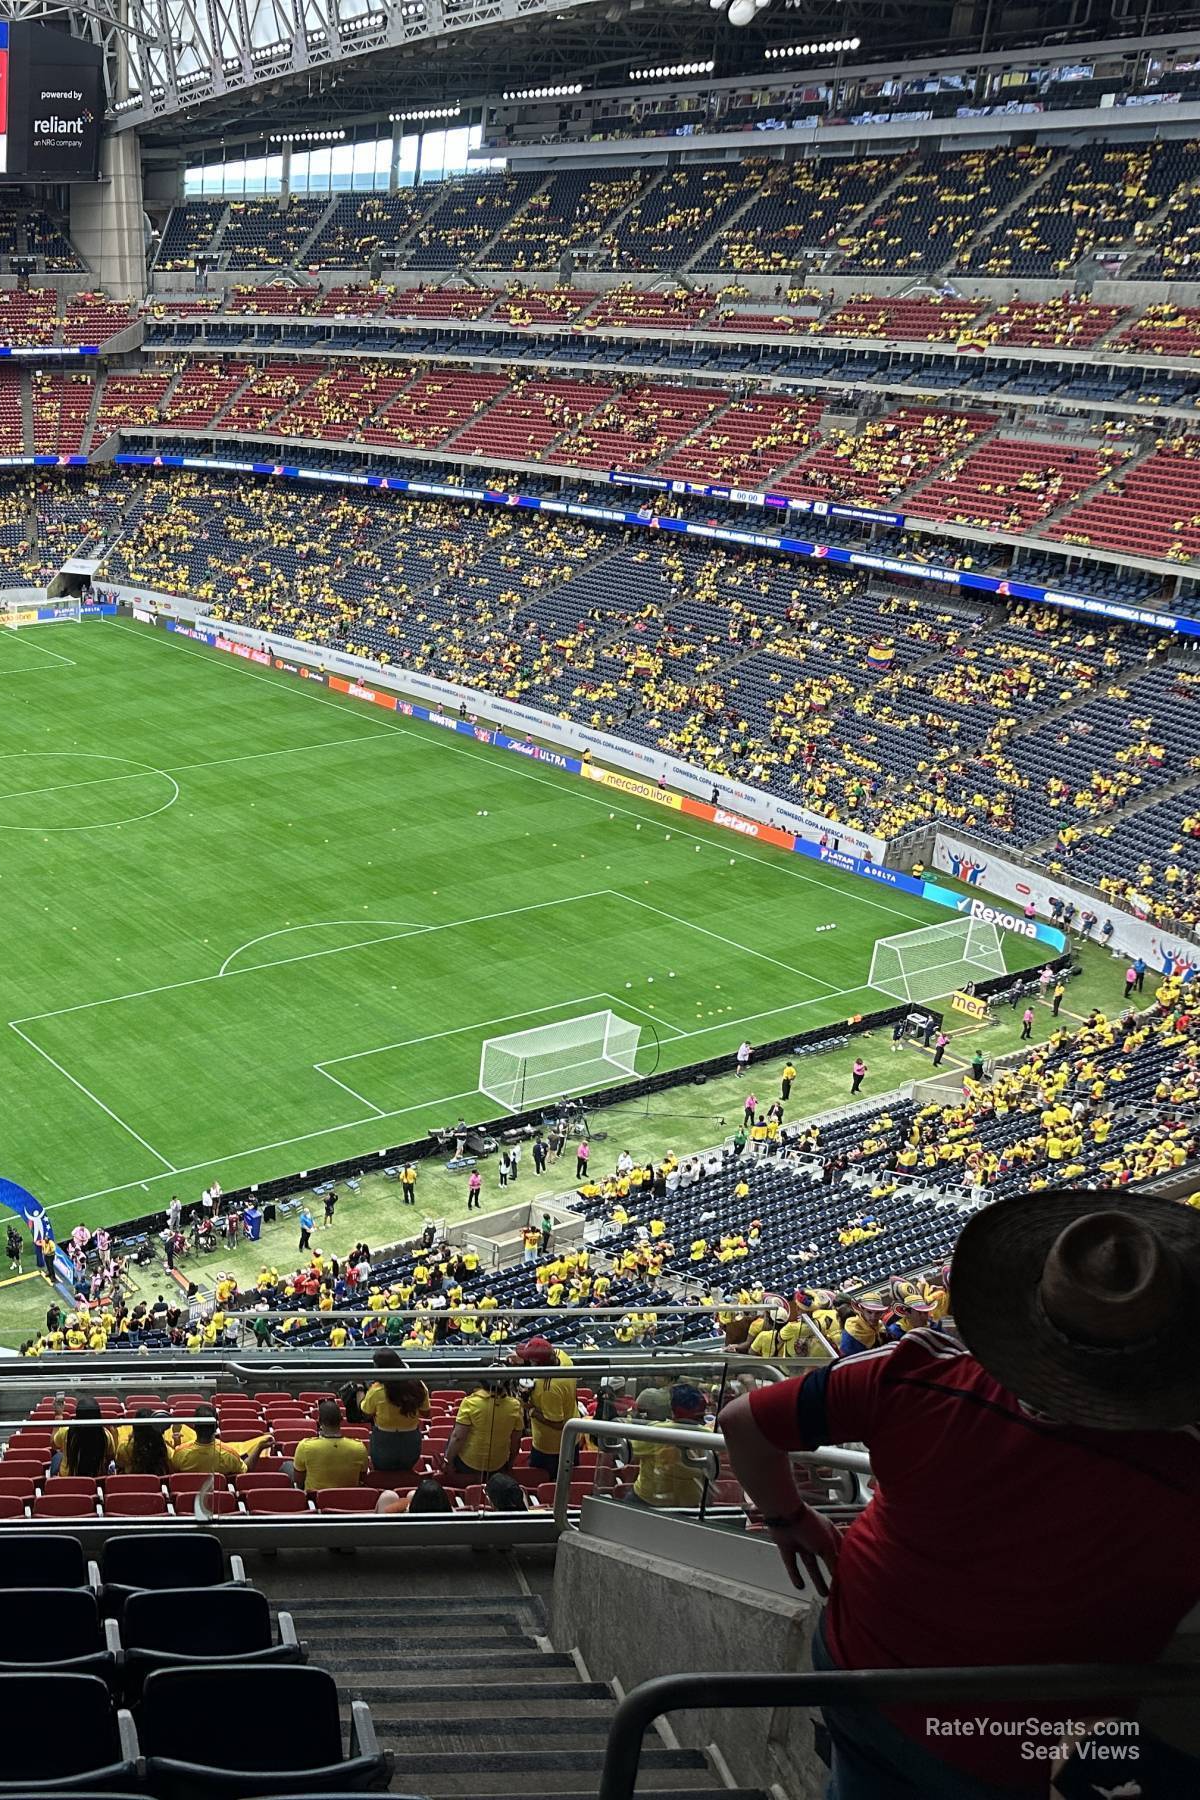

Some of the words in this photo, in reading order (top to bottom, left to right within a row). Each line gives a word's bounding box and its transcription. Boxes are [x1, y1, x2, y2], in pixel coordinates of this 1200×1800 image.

[41, 90, 72, 100] powered
[73, 90, 82, 101] by
[34, 117, 83, 134] reliant
[55, 140, 82, 148] company
[429, 712, 457, 730] HOUSTON
[578, 731, 601, 744] CONMEBOL
[602, 740, 614, 749] COPA
[614, 744, 634, 758] AMERICA
[634, 752, 643, 760] USA
[643, 754, 655, 764] 2024
[540, 751, 567, 767] ULTRA
[607, 773, 649, 797] mercado
[651, 787, 673, 804] libre
[672, 766, 699, 781] CONMEBOL
[699, 776, 712, 787] COPA
[712, 781, 734, 796] AMERICA
[734, 790, 743, 798] USA
[744, 793, 756, 803] 2024
[712, 810, 758, 836] Betano
[776, 807, 805, 824] CONMEBOL
[805, 819, 819, 830] COPA
[819, 825, 844, 839] AMERICA
[844, 835, 855, 845] USA
[855, 839, 869, 849] 2024
[828, 851, 855, 865] LATAM
[828, 859, 854, 871] AIRLINES
[871, 868, 896, 882] DELTA
[970, 899, 1038, 938] Rexona
[952, 993, 984, 1019] mer
